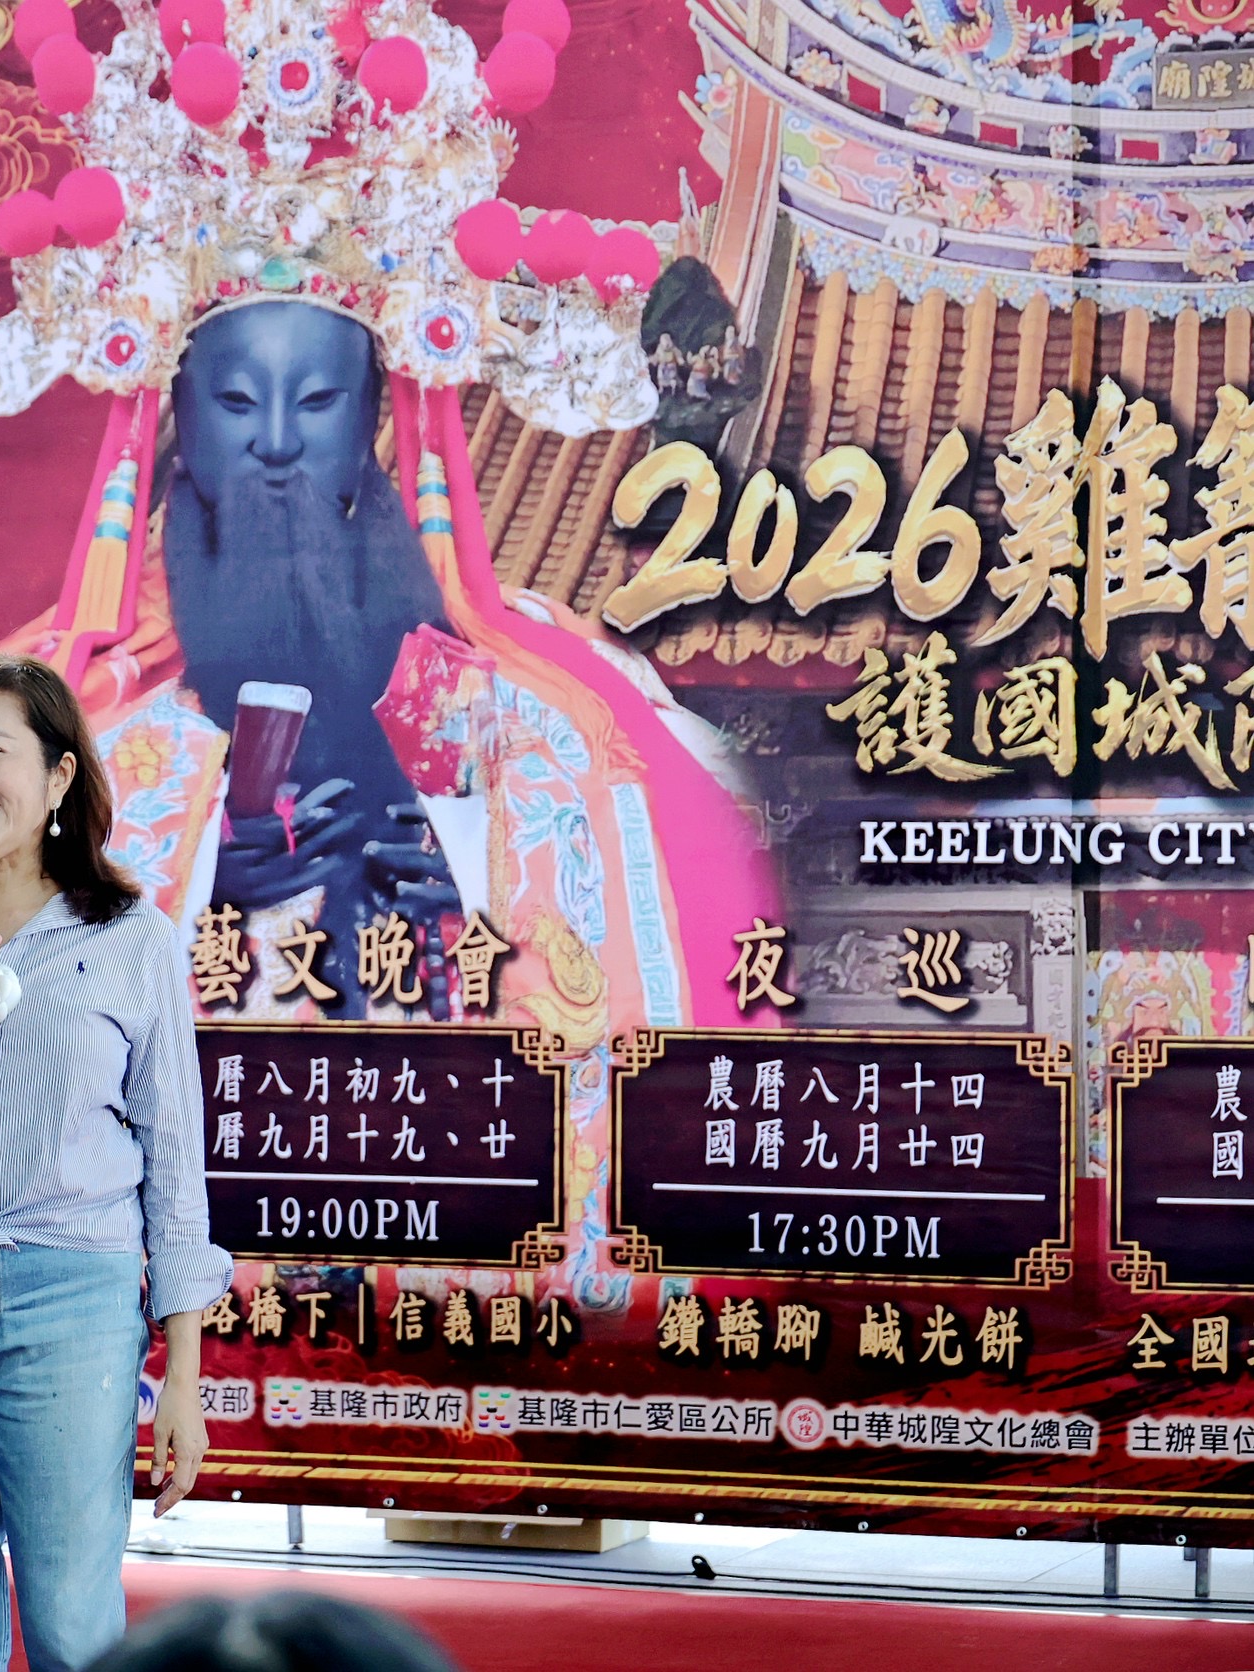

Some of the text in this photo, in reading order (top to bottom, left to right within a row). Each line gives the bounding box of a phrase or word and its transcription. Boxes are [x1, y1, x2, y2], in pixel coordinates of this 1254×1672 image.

[826, 630, 1254, 790] 護國城
[860, 821, 1254, 865] KEELUNG CIT
[190, 903, 511, 1008] 藝文晚會
[726, 918, 970, 1014] 夜巡
[704, 1054, 985, 1115] 農曆八月十四
[1210, 1064, 1248, 1122] 農
[704, 1118, 985, 1173] 國曆九月廿四
[1212, 1129, 1244, 1180] 國
[255, 1196, 441, 1242] 19:00PM
[748, 1212, 941, 1259] 17:30PM
[390, 1289, 573, 1347] 信義國小
[859, 1302, 1023, 1369] 鹹光餅
[1127, 1313, 1254, 1374] 全國
[310, 1388, 464, 1422] 基隆市政府
[518, 1396, 772, 1437] 基隆市仁愛區公所
[833, 1410, 1095, 1450] 中華城隍文化總會
